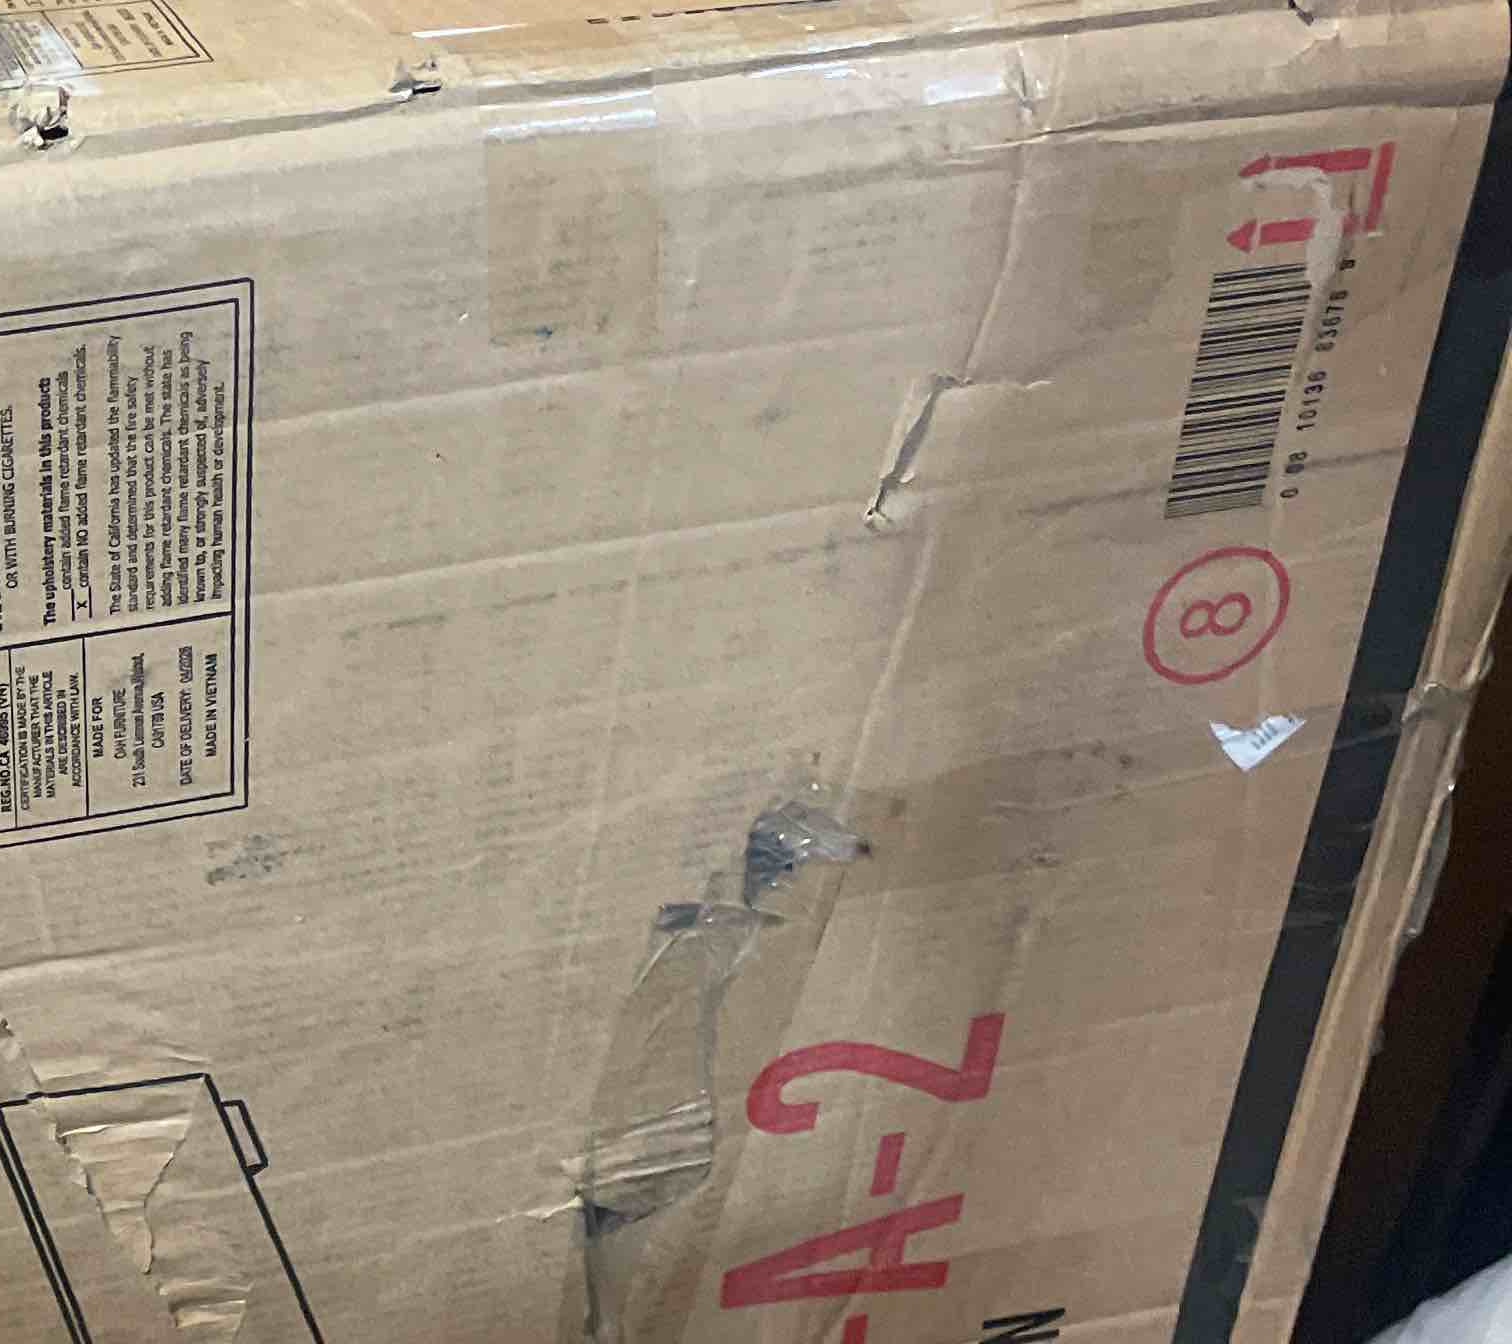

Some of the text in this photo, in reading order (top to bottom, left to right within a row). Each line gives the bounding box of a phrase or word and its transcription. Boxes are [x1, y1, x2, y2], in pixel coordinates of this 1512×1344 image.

[107, 405, 119, 424] the
[74, 403, 87, 456] retardant
[38, 432, 52, 457] this
[40, 458, 52, 472] in
[108, 474, 120, 495] has
[3, 481, 17, 534] BURNING
[40, 474, 54, 532] materials
[108, 496, 120, 548] California
[77, 528, 88, 546] NO
[5, 536, 18, 569] WITH
[109, 549, 120, 562] of
[6, 570, 18, 589] OR
[41, 535, 58, 600] upholstery
[43, 601, 56, 625] The
[77, 599, 87, 610] X
[110, 592, 121, 614] The
[1180, 591, 1252, 640] 8
[204, 653, 217, 757] MADE IN VIETNAM
[91, 696, 104, 758] MADE FOR
[179, 742, 192, 757] OF
[179, 758, 192, 785] DATE
